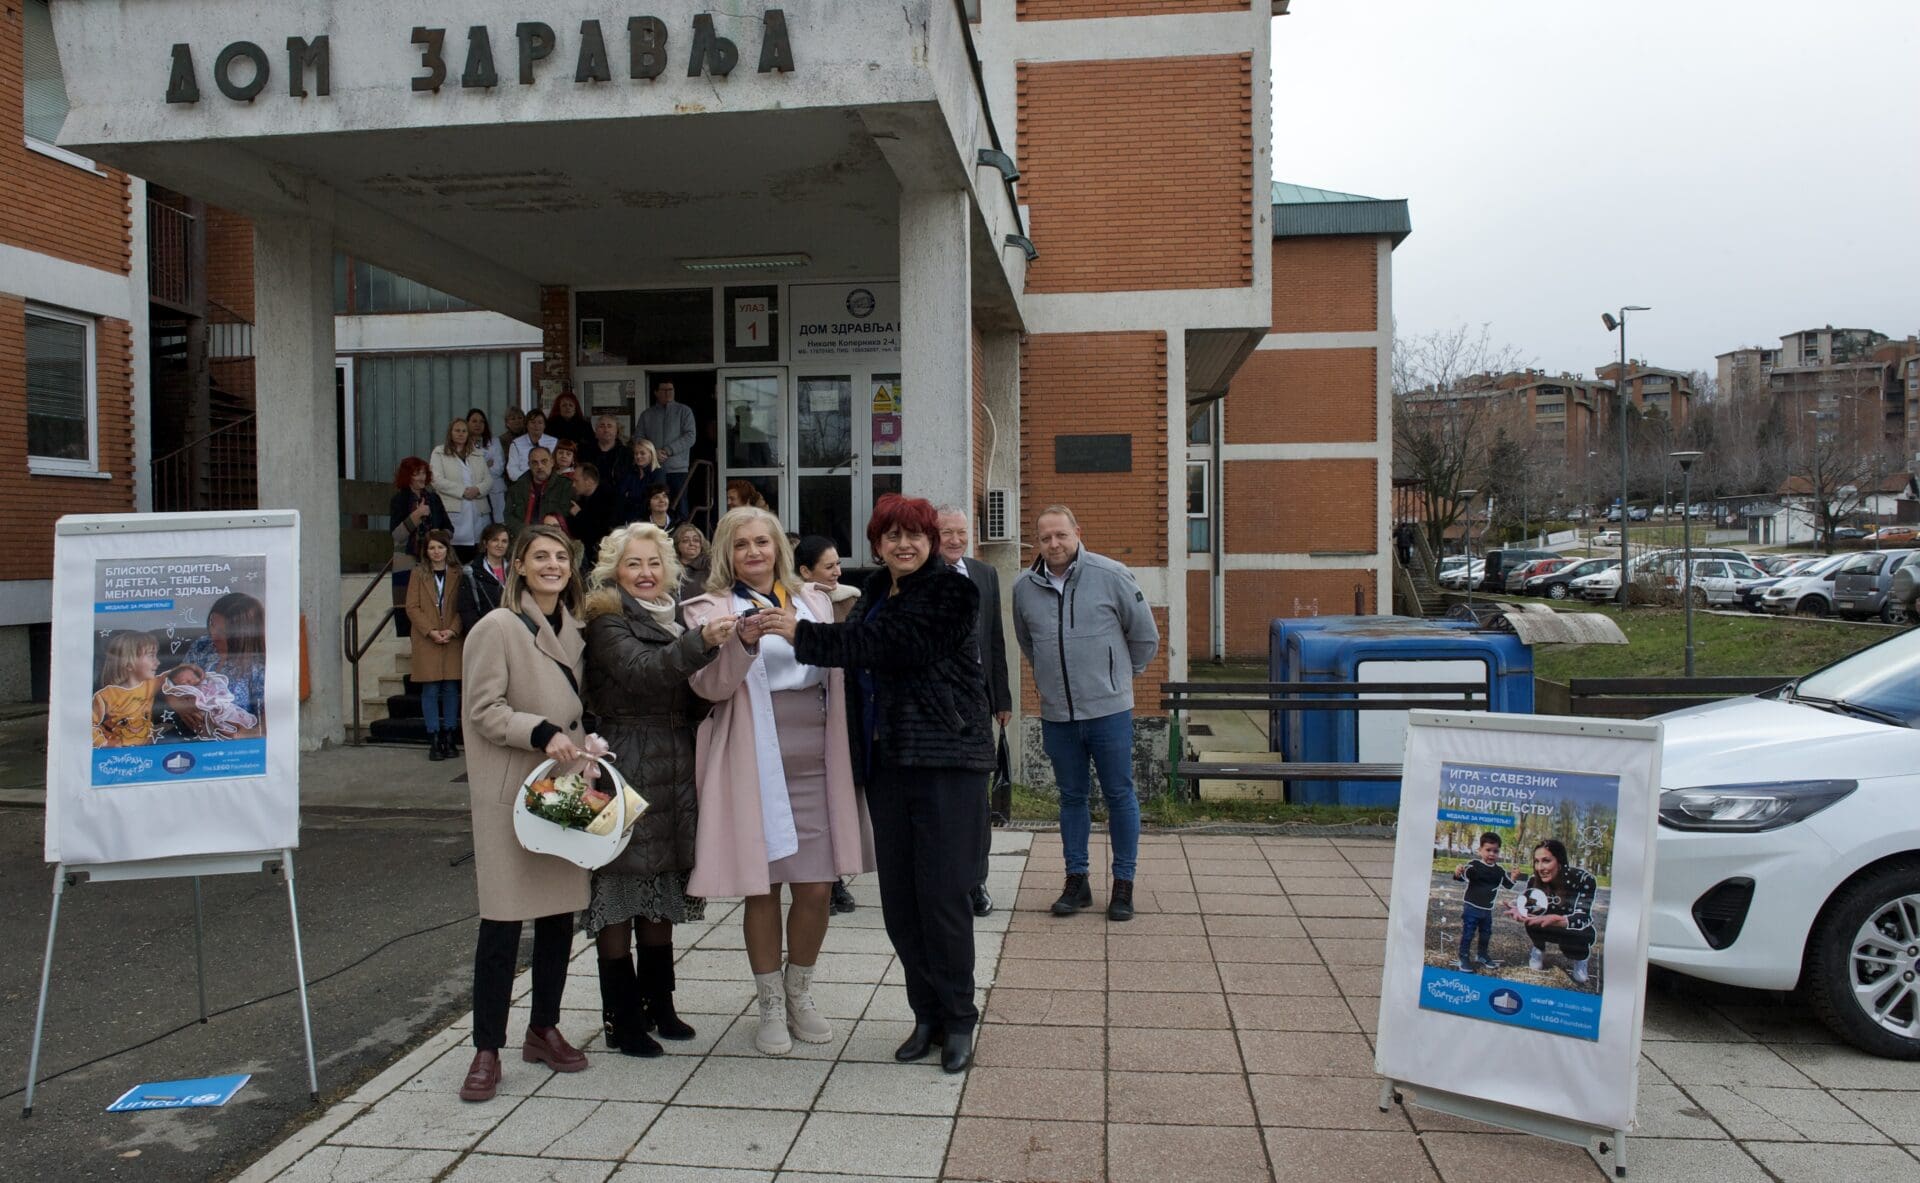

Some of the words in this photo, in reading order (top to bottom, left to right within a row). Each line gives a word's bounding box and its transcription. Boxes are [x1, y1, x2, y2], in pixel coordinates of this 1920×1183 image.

[166, 35, 329, 103] ДОМ
[411, 9, 795, 91] ЗДРАВЉА
[739, 303, 765, 312] УЛАЗ
[747, 320, 757, 341] 1
[799, 324, 828, 336] ДОМ
[831, 322, 894, 335] ЗДРАВЉА
[105, 565, 165, 576] БЛИСКОСТ
[168, 563, 231, 575] РОДИТЕЉА
[105, 578, 113, 588] И
[115, 577, 158, 588] ДЕТЕТА
[171, 575, 211, 586] ТЕМЕЉ
[105, 588, 172, 600] МЕНТАЛНОГ
[175, 586, 231, 598] ЗДРАВЉА
[1450, 768, 1480, 781] ИГРА
[1490, 772, 1558, 788] САВЕЗНИК
[1449, 782, 1457, 793] У
[1459, 783, 1536, 800] ОДРАСТАЊУ
[1448, 796, 1456, 806] И
[1459, 798, 1554, 816] РОДИТЕЉСТВУ
[1541, 1015, 1559, 1024] LEGO
[117, 1095, 195, 1109] unicef
